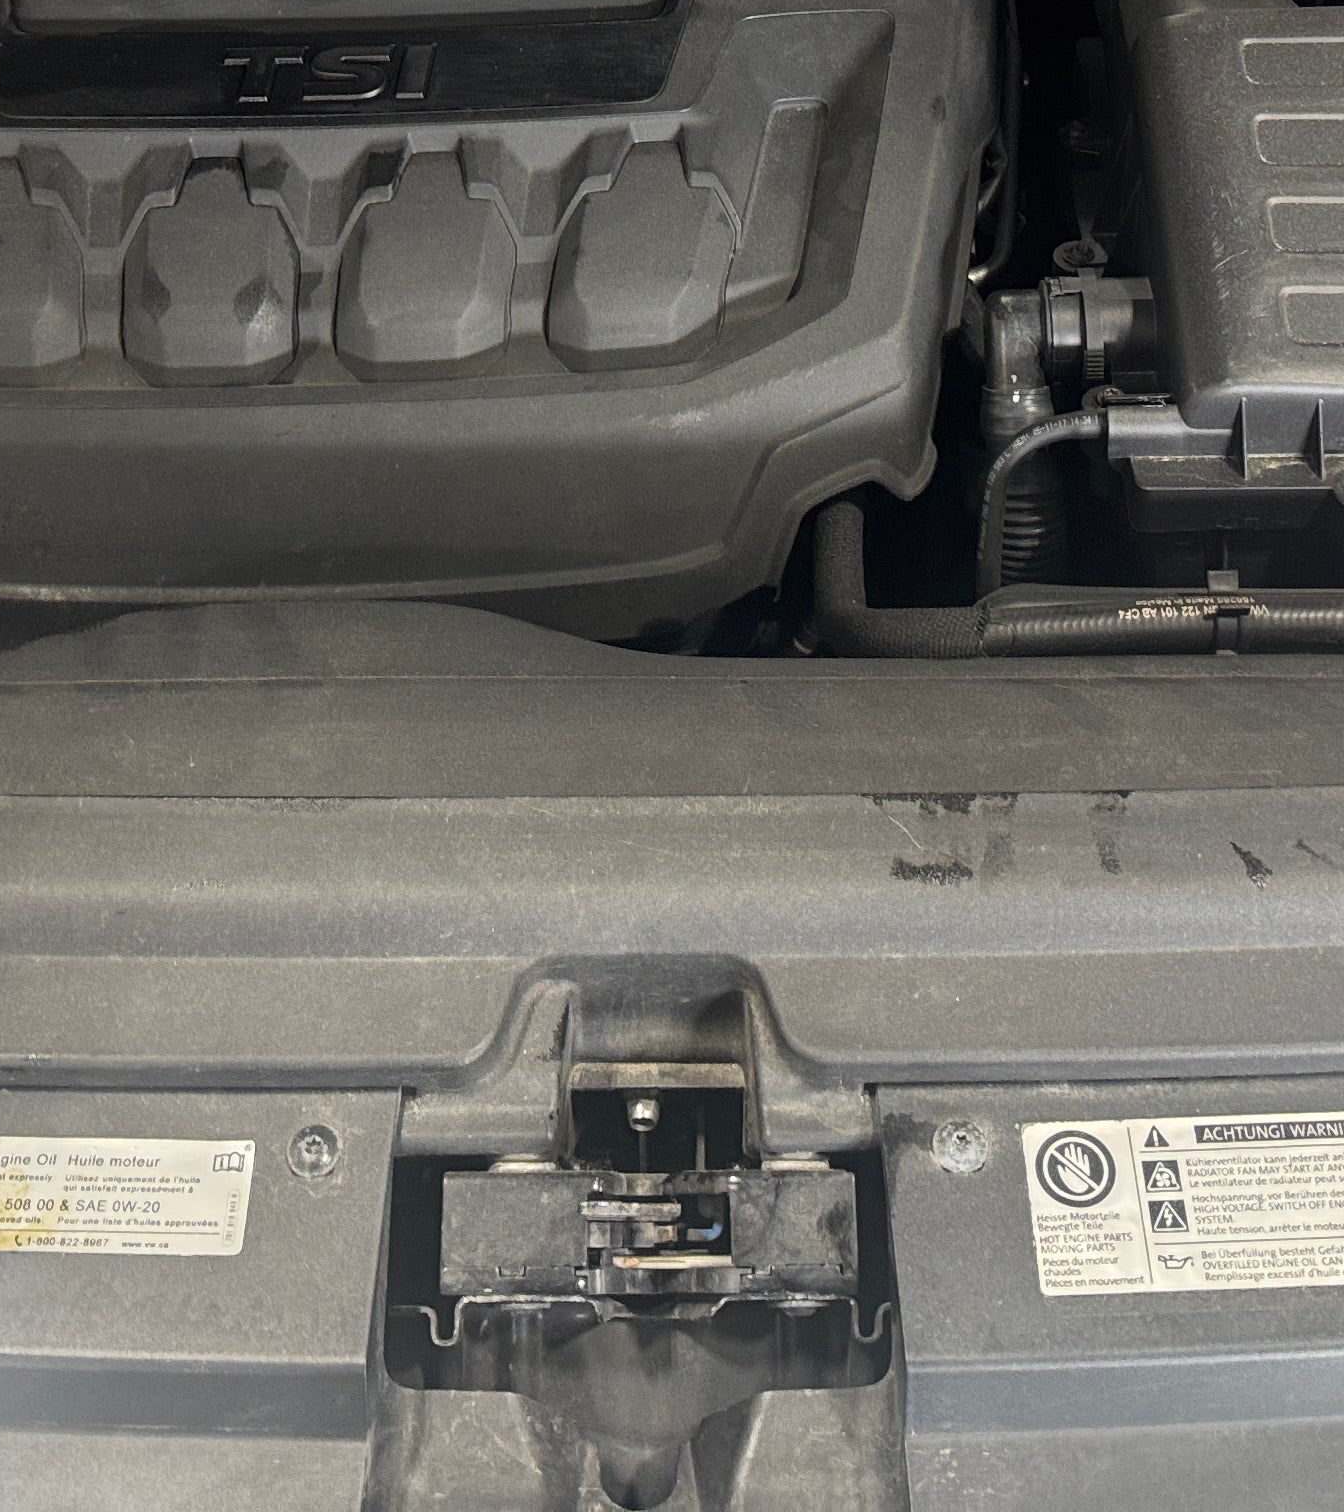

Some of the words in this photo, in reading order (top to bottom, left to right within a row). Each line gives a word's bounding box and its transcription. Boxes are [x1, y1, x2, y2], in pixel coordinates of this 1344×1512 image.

[222, 42, 437, 103] TSI
[1118, 608, 1140, 620] CF4
[1142, 607, 1157, 618] AB
[1160, 606, 1177, 617] 101
[1181, 606, 1200, 616] 122
[1202, 1124, 1286, 1142] ACHTUNG!
[36, 1154, 56, 1166] Oil
[68, 1154, 104, 1166] Huile
[110, 1156, 160, 1168] moteur
[1264, 1155, 1287, 1164] kann
[1289, 1153, 1329, 1164] jederzeit
[1187, 1168, 1234, 1177] RADIATOR
[1238, 1166, 1256, 1175] FAN
[1258, 1166, 1280, 1174] MAY
[1283, 1164, 1310, 1173] START
[1314, 1164, 1324, 1172] AT
[9, 1174, 52, 1182] expressly
[158, 1176, 170, 1184] de
[174, 1176, 201, 1184] l'huile
[1189, 1179, 1200, 1188] Le
[1202, 1176, 1253, 1187] ventilateur
[1256, 1176, 1267, 1185] de
[1270, 1174, 1312, 1184] radiateur
[1316, 1174, 1336, 1185] peut
[63, 1184, 77, 1192] qui
[1268, 1192, 1282, 1200] vor
[1284, 1190, 1328, 1200] Berühren
[1330, 1190, 1344, 1198] der
[4, 1198, 31, 1210] 508
[36, 1198, 54, 1211] 00
[60, 1199, 68, 1212] &
[76, 1199, 107, 1212] SAE
[112, 1200, 160, 1214] 0W-20
[1194, 1205, 1220, 1213] HIGH
[1269, 1201, 1306, 1210] SWITCH
[1308, 1200, 1326, 1209] OFF
[57, 1216, 78, 1224] Pour
[102, 1218, 122, 1226] liste
[126, 1218, 160, 1226] d'huiles
[164, 1219, 218, 1228] approuvées
[1036, 1214, 1068, 1222] Heisse
[1070, 1212, 1120, 1221] Motorteile
[1038, 1224, 1080, 1232] Bewegte
[1082, 1222, 1104, 1230] Teile
[1197, 1226, 1227, 1236] Haute
[1304, 1223, 1312, 1231] le
[1040, 1234, 1060, 1244] HOT
[1064, 1233, 1102, 1243] ENGINE
[1104, 1232, 1133, 1241] PARTS
[1040, 1244, 1084, 1254] MOVING
[1086, 1242, 1116, 1252] PARTS
[1201, 1250, 1216, 1259] Bei
[1280, 1247, 1316, 1256] besteht
[1072, 1258, 1083, 1266] du
[1086, 1256, 1120, 1265] moteur
[1203, 1260, 1260, 1269] OVERFILLED
[1262, 1258, 1300, 1267] ENGINE
[1302, 1258, 1317, 1266] OIL
[1322, 1256, 1342, 1265] CAN
[1044, 1268, 1081, 1276] chaudes
[1205, 1272, 1265, 1282] Remplissage
[1268, 1269, 1304, 1279] excessif
[1308, 1268, 1341, 1278] d'huile
[1089, 1275, 1145, 1286] mouvement
